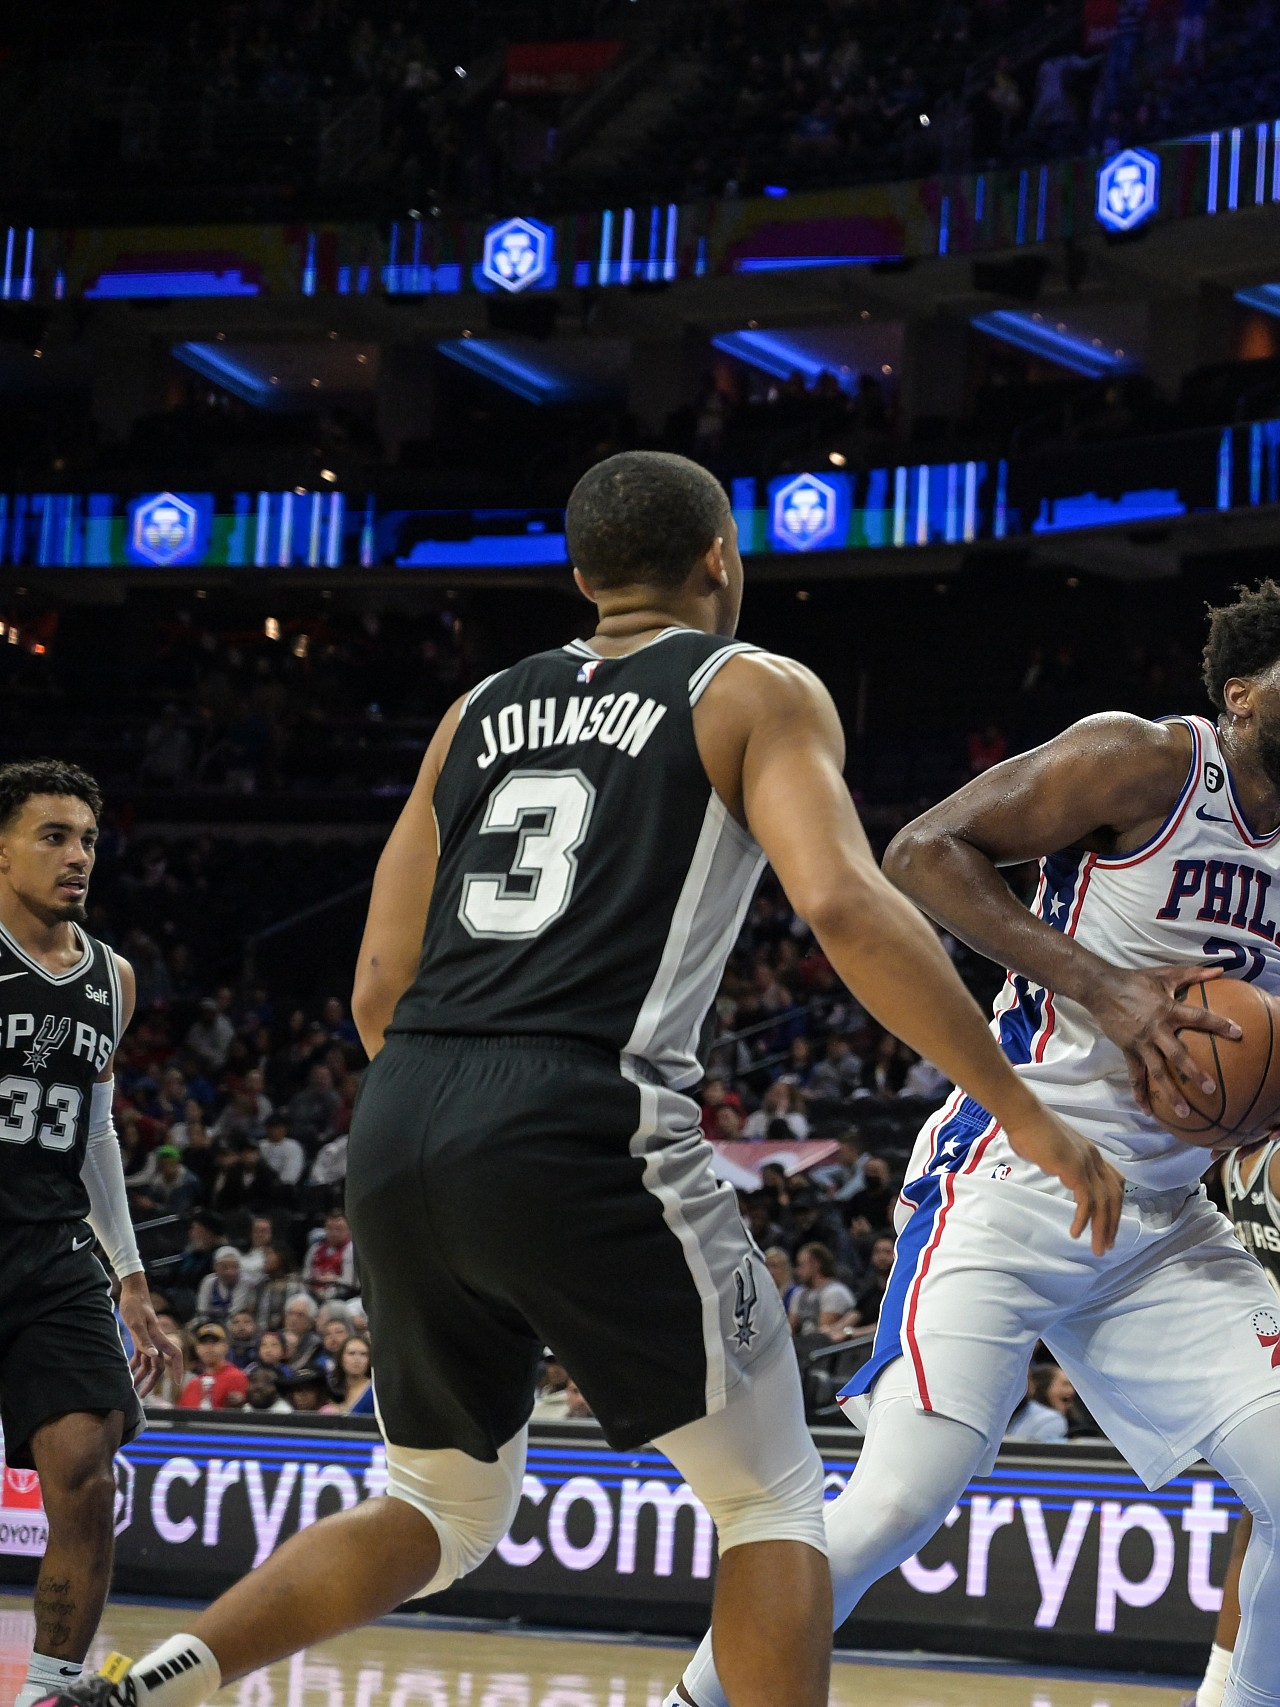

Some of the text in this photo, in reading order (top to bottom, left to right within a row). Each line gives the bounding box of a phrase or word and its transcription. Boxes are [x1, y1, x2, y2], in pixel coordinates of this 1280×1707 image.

[476, 691, 668, 769] JOHNSON
[1206, 766, 1220, 790] 6
[457, 768, 597, 940] 3
[0, 1013, 113, 1073] PURS
[0, 1074, 83, 1152] 33
[0, 1522, 48, 1546] OYOTA
